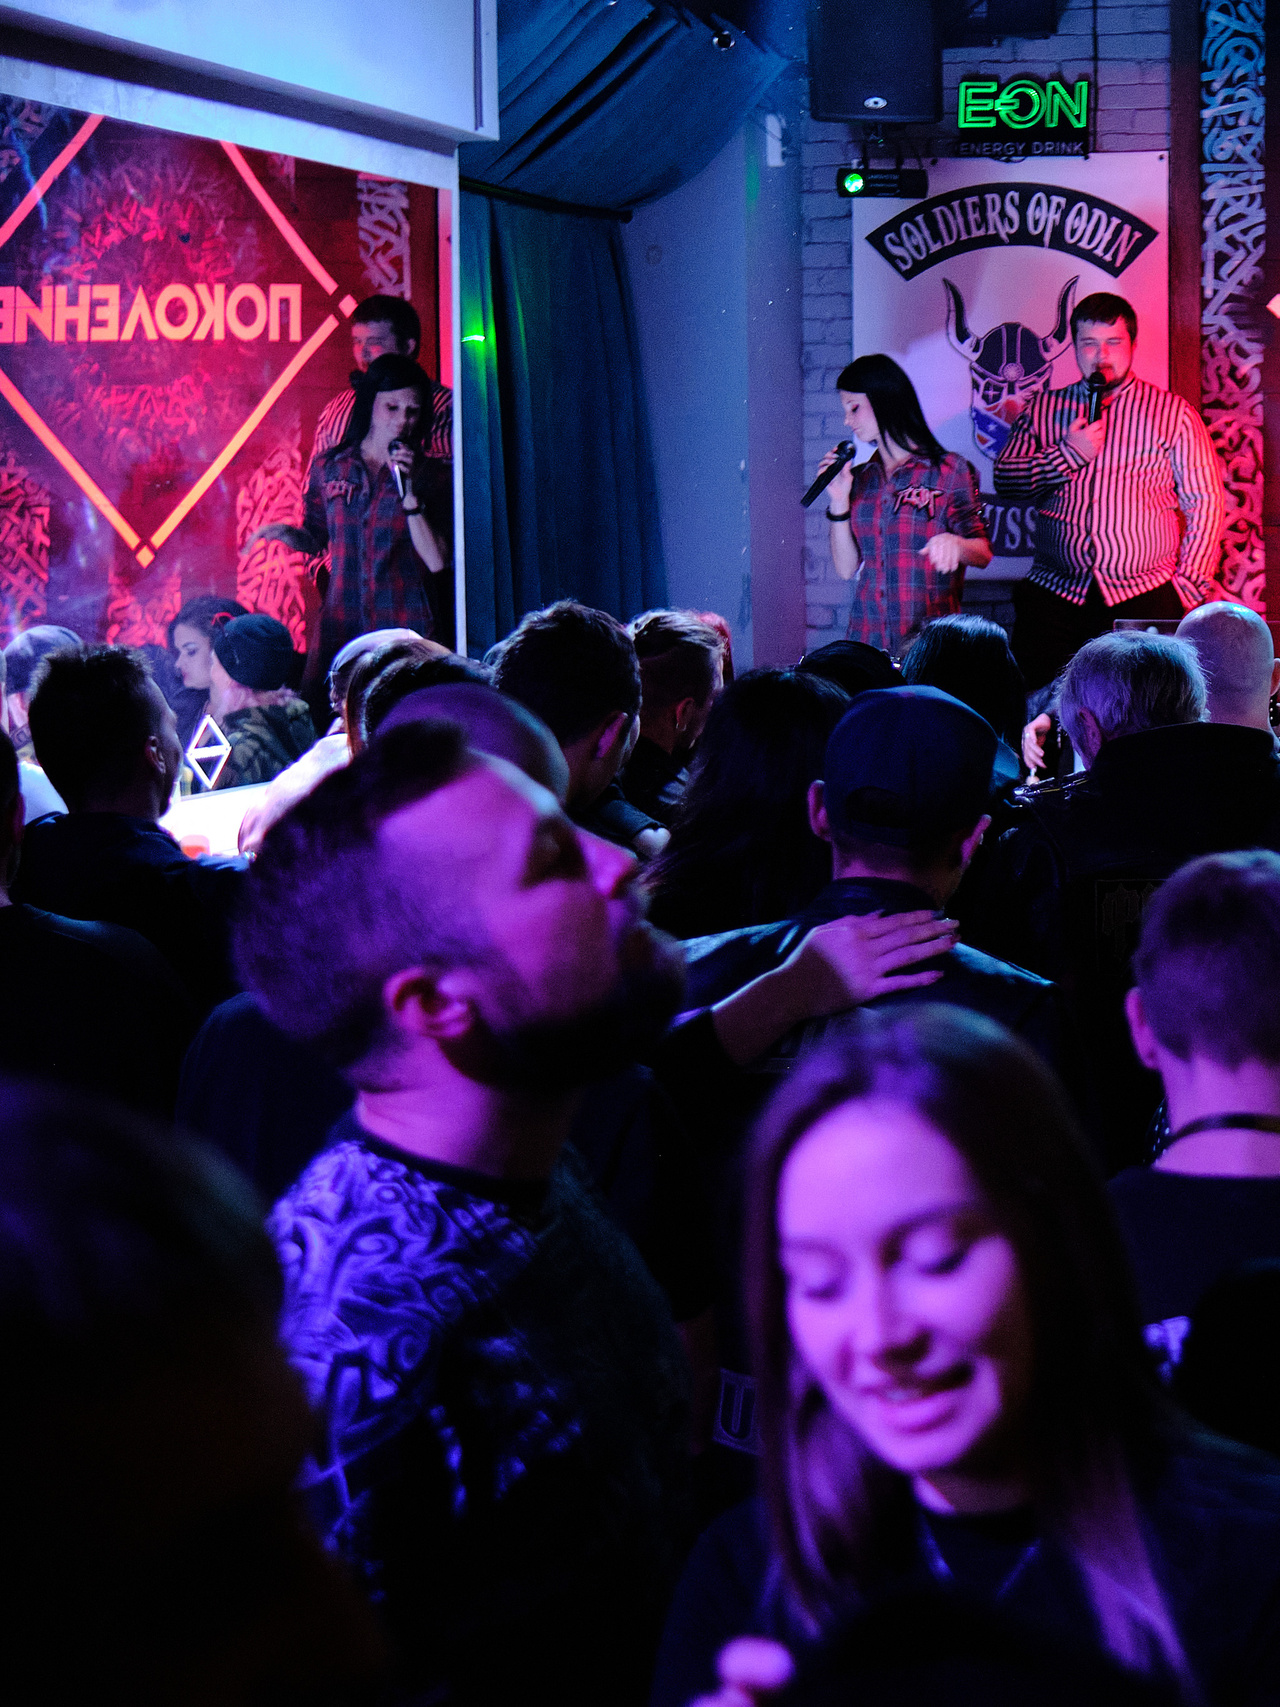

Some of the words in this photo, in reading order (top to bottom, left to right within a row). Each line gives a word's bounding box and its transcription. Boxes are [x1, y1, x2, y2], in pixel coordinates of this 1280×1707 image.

[958, 80, 1088, 129] EON
[959, 142, 1026, 155] ENERGY
[1031, 141, 1084, 155] DRINK
[884, 190, 1021, 272] SOLDIERS
[1026, 191, 1067, 248] OF
[1063, 201, 1143, 268] ODIN
